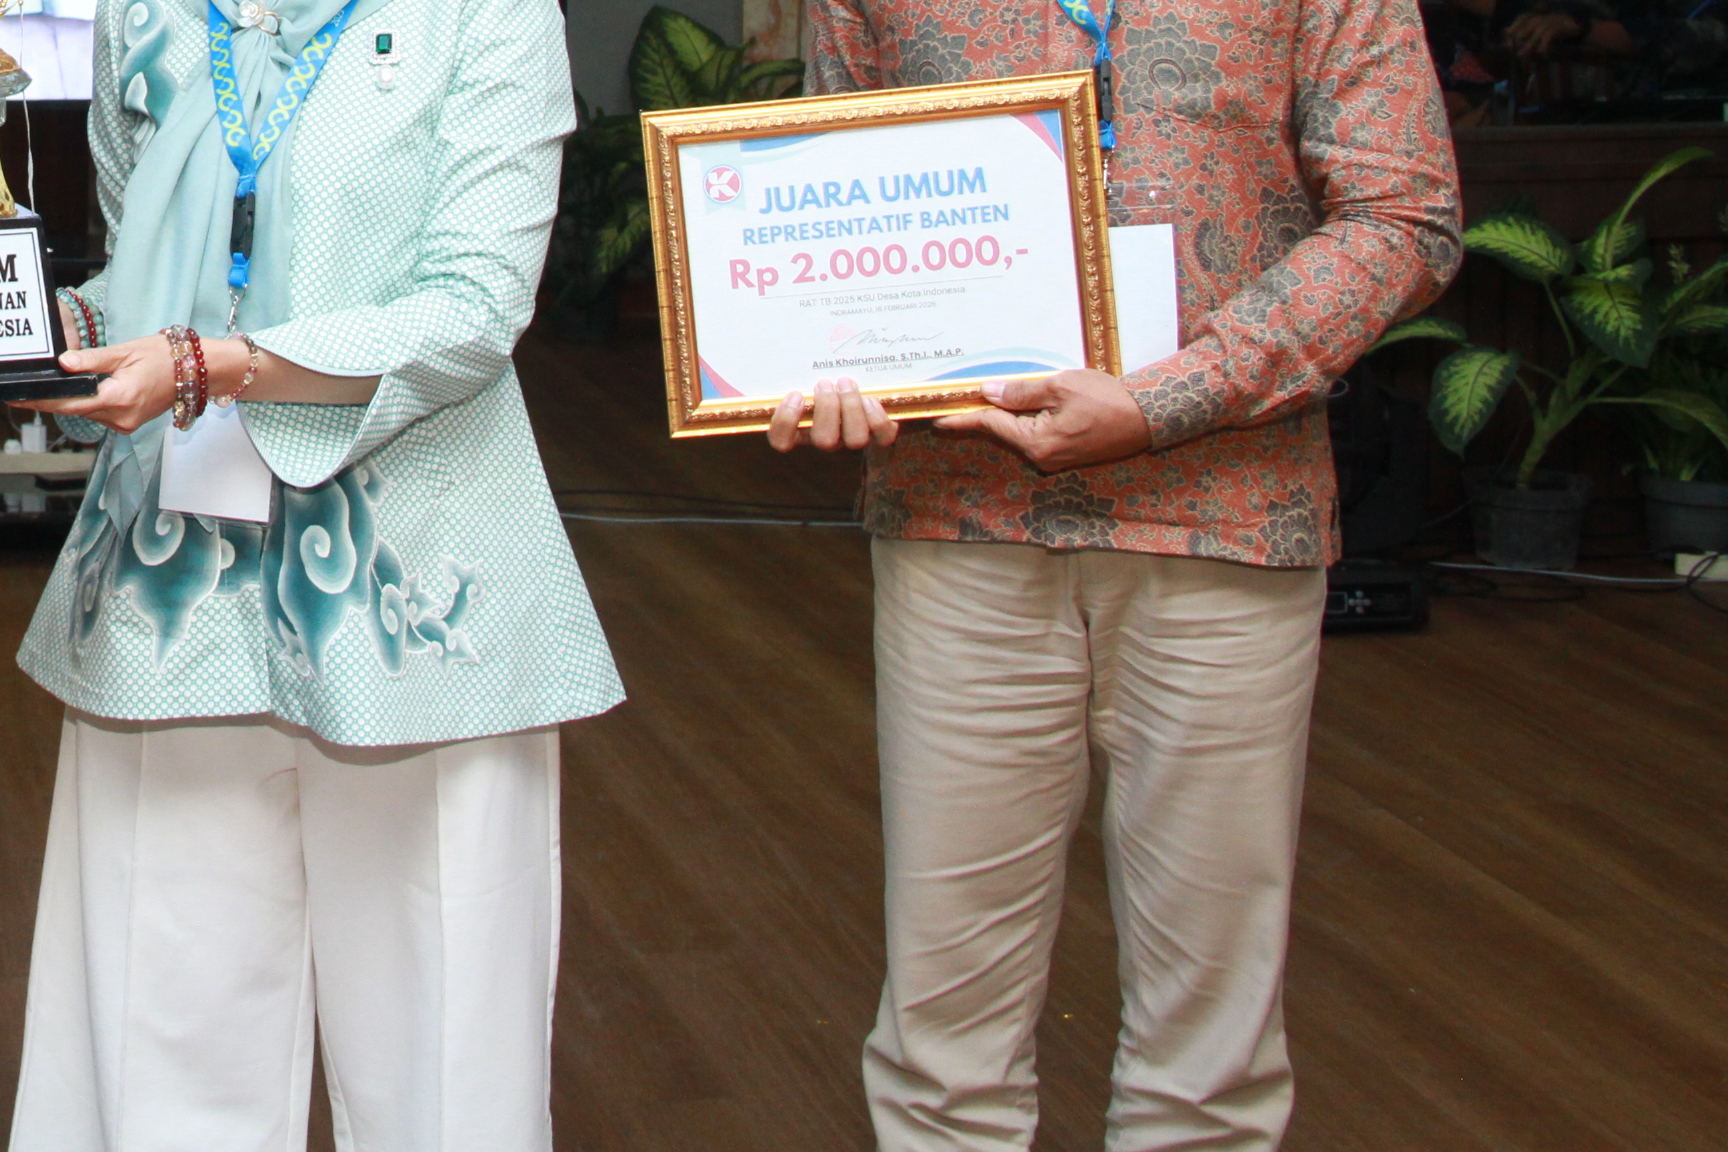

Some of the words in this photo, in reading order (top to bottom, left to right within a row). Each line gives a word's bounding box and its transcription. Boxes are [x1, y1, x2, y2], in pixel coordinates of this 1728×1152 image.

[759, 178, 872, 215] JUARA
[878, 166, 988, 203] UMUM
[742, 212, 913, 247] REPRESENTATIF
[919, 203, 1010, 230] BANTEN
[729, 258, 780, 297] Rp
[790, 234, 1029, 284] 2.000.000,-
[799, 298, 817, 308] RAT
[820, 297, 831, 306] TB
[833, 295, 855, 305] 2025
[857, 293, 875, 303] KSU
[877, 291, 899, 301] Desa
[901, 289, 921, 299] Kota
[923, 286, 966, 297] Indonesia
[883, 303, 917, 312] FEBRUARI
[812, 360, 834, 370] Anis
[933, 347, 965, 358] M.A.P.
[865, 364, 888, 373] KETUA
[889, 362, 913, 371] UMUM
